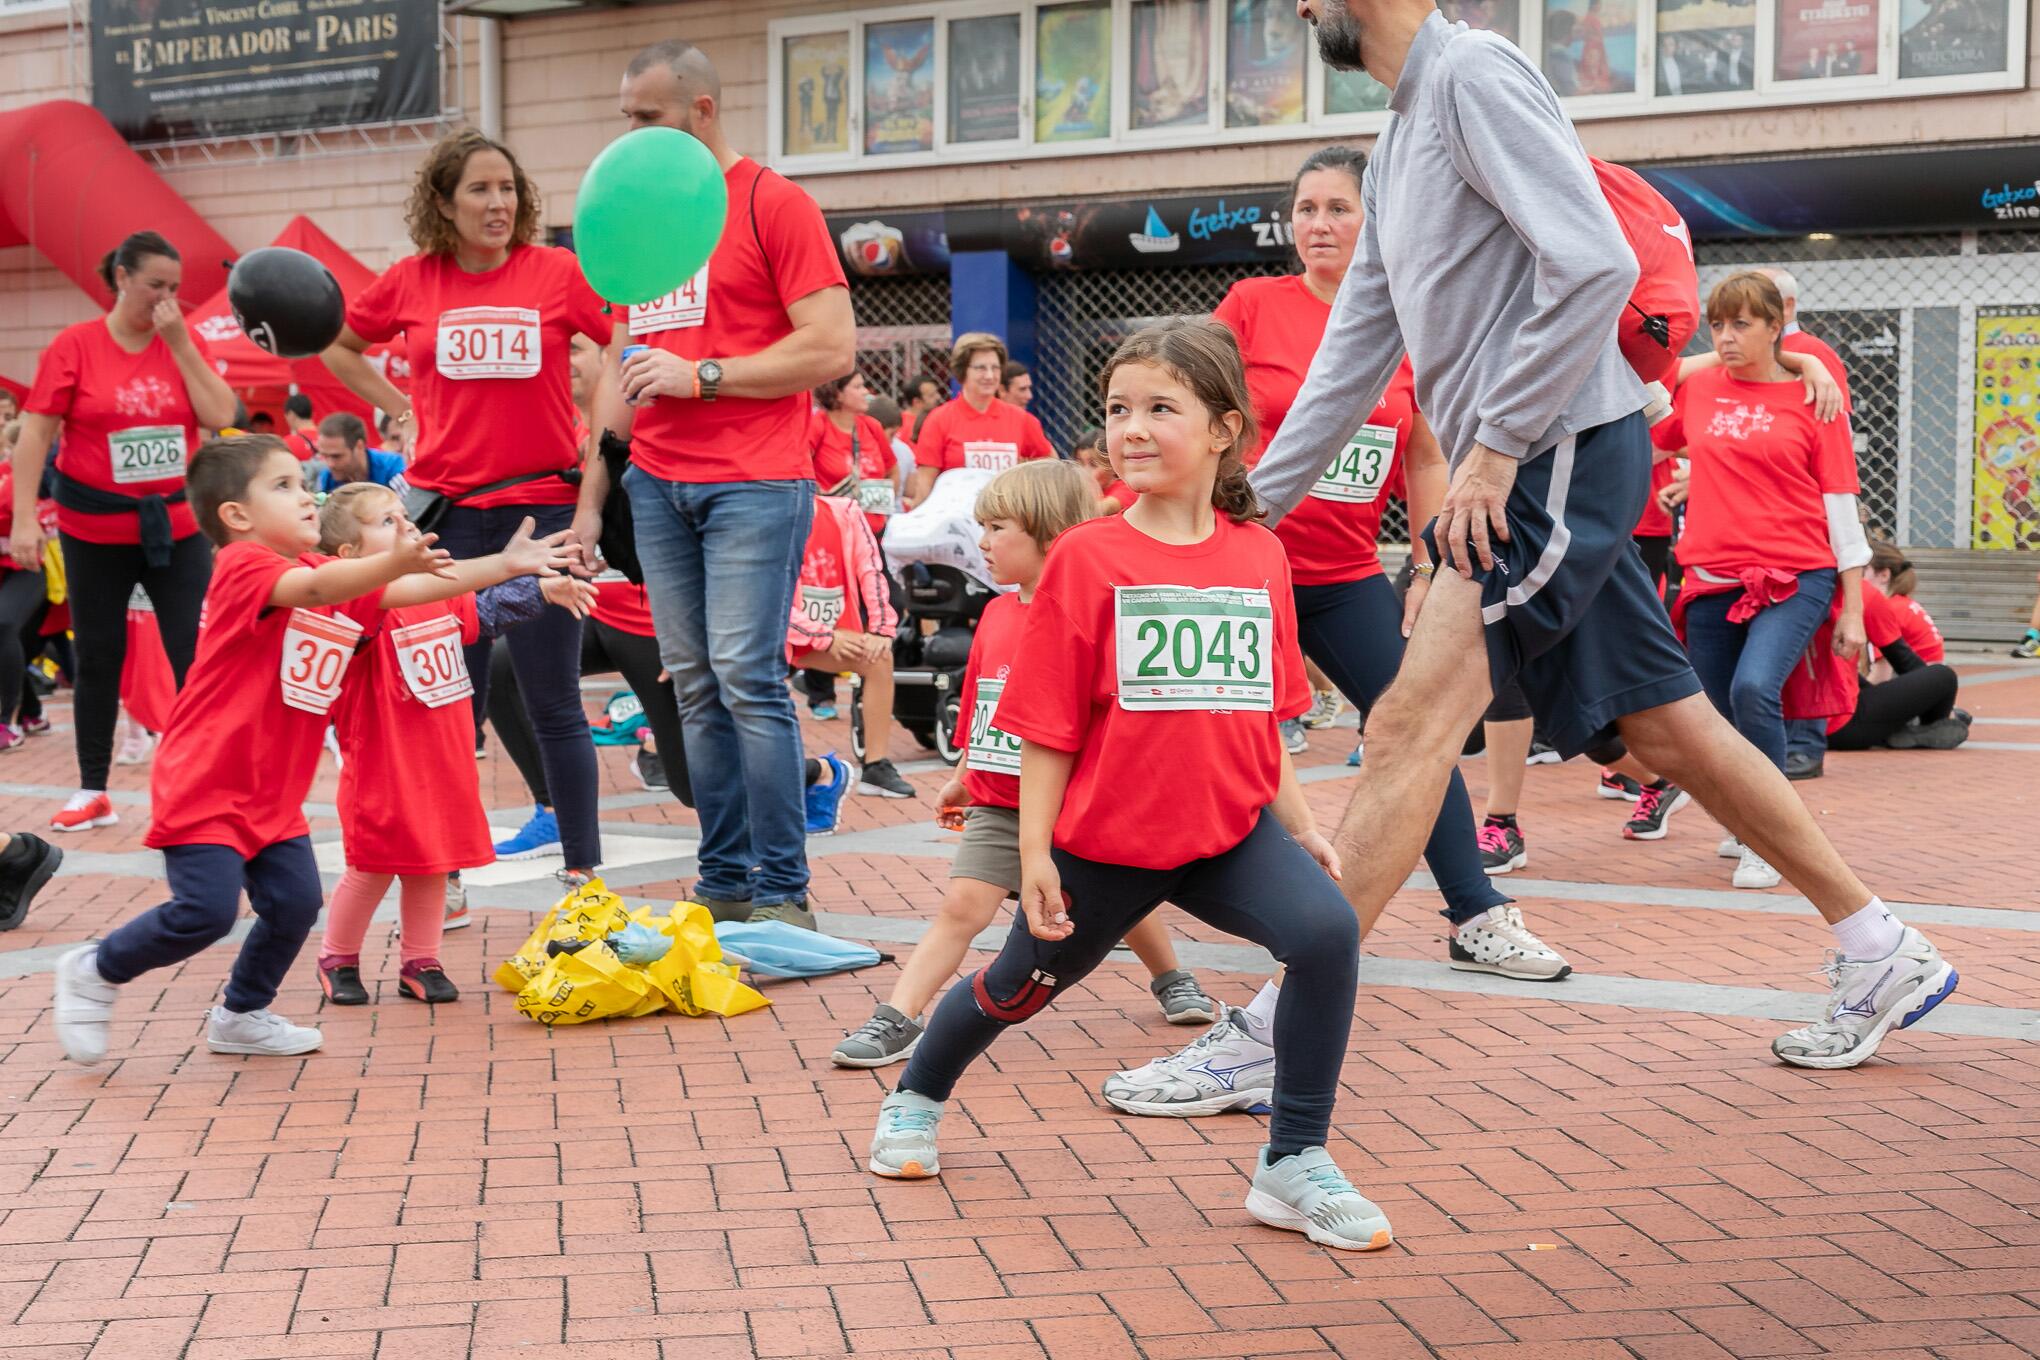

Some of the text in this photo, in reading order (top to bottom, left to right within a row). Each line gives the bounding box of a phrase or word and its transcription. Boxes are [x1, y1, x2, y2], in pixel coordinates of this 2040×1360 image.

[132, 27, 291, 73] EMPERADOR
[315, 13, 398, 52] PARIS
[1982, 183, 2036, 208] Getxo
[1188, 200, 1261, 240] Getxo
[448, 328, 530, 362] 3014
[121, 439, 180, 468] 2026
[1137, 618, 1261, 680] 2043
